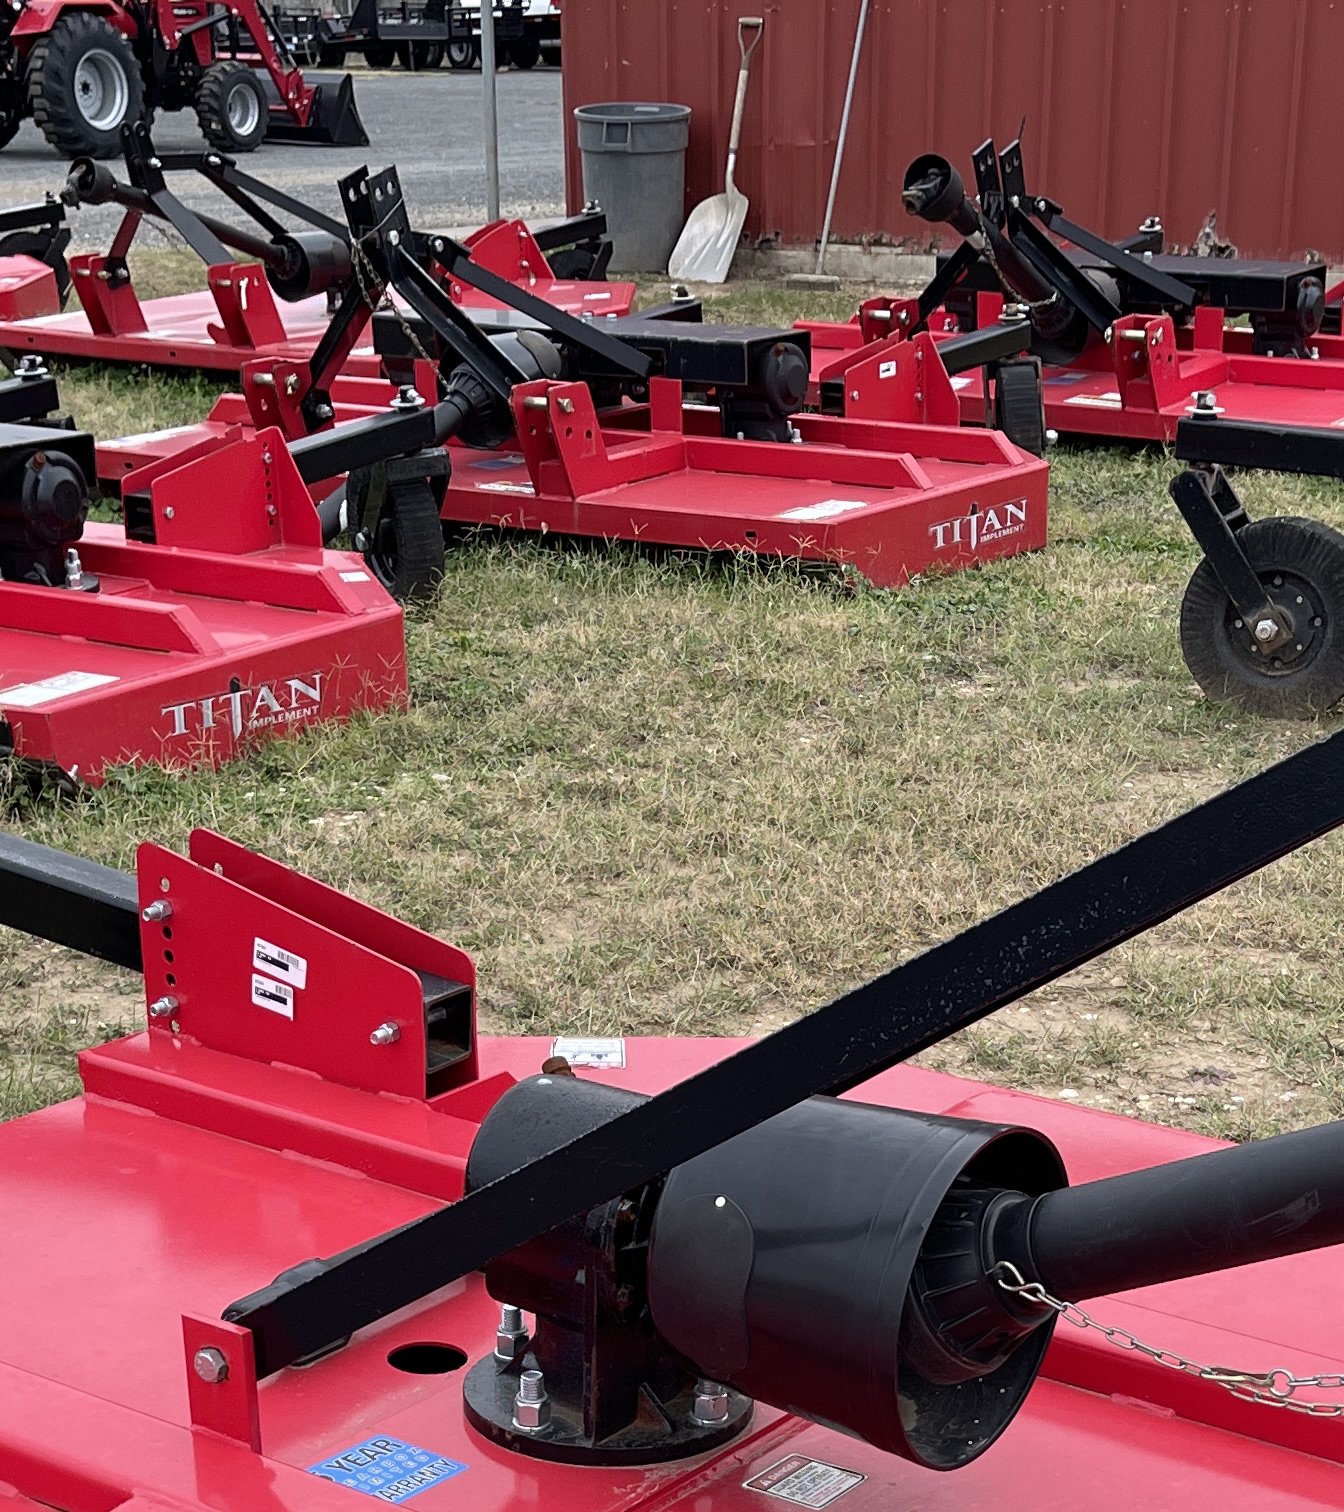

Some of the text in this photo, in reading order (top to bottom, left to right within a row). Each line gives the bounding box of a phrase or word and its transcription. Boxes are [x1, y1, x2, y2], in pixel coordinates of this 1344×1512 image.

[928, 499, 1027, 550] TITAN
[979, 523, 1025, 543] IMPLEMENT
[161, 672, 322, 739] TITAN
[325, 1439, 403, 1473] YEAR
[375, 1457, 456, 1500] ARRANTY
